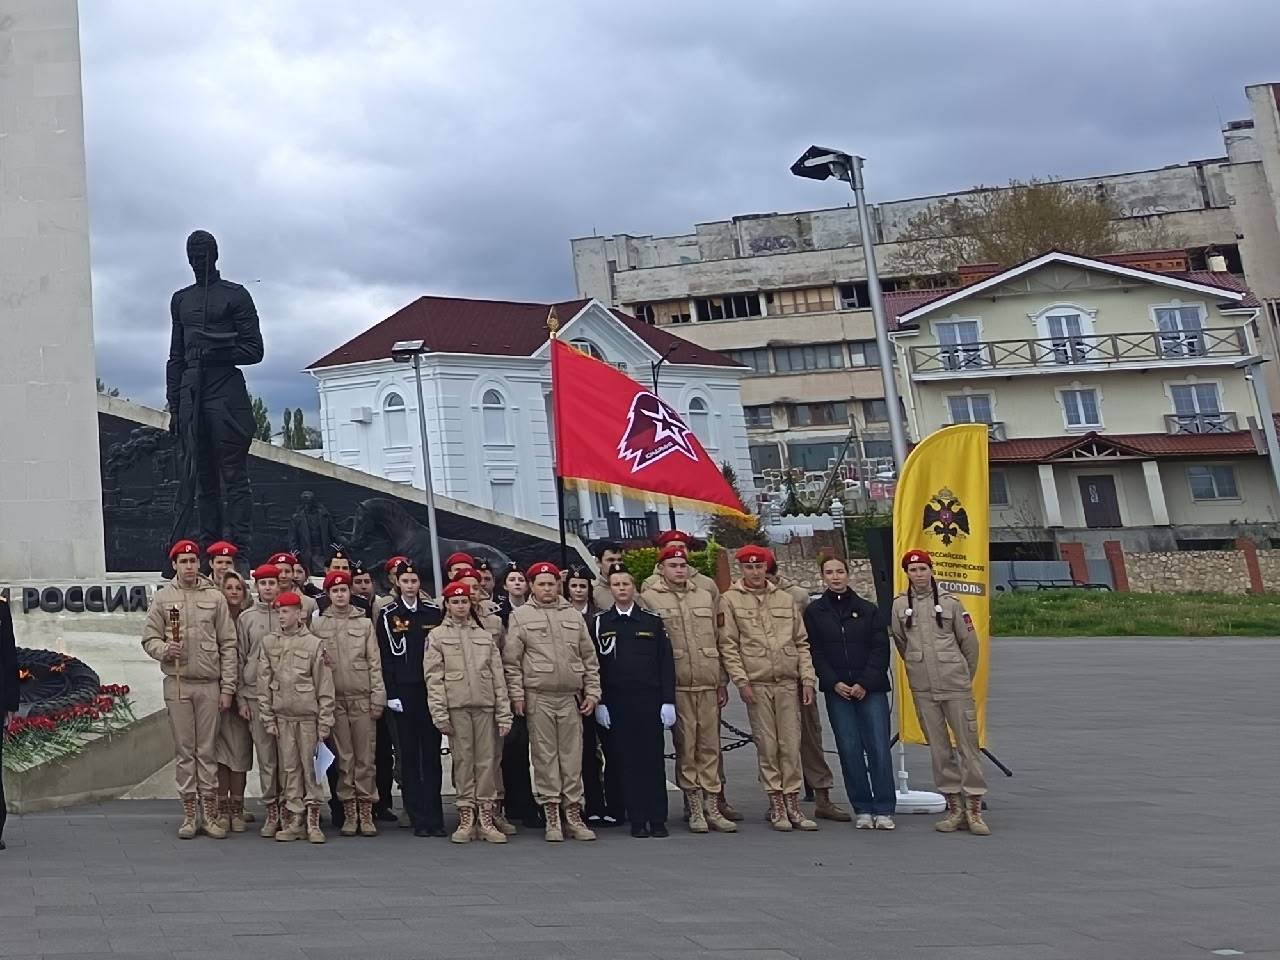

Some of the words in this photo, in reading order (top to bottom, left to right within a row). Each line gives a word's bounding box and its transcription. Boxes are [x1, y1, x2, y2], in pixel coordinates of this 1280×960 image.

[932, 569, 968, 579] БЩЕСТВО
[938, 581, 982, 593] СТОПОЛЬ
[22, 585, 149, 614] РОССИЯ
